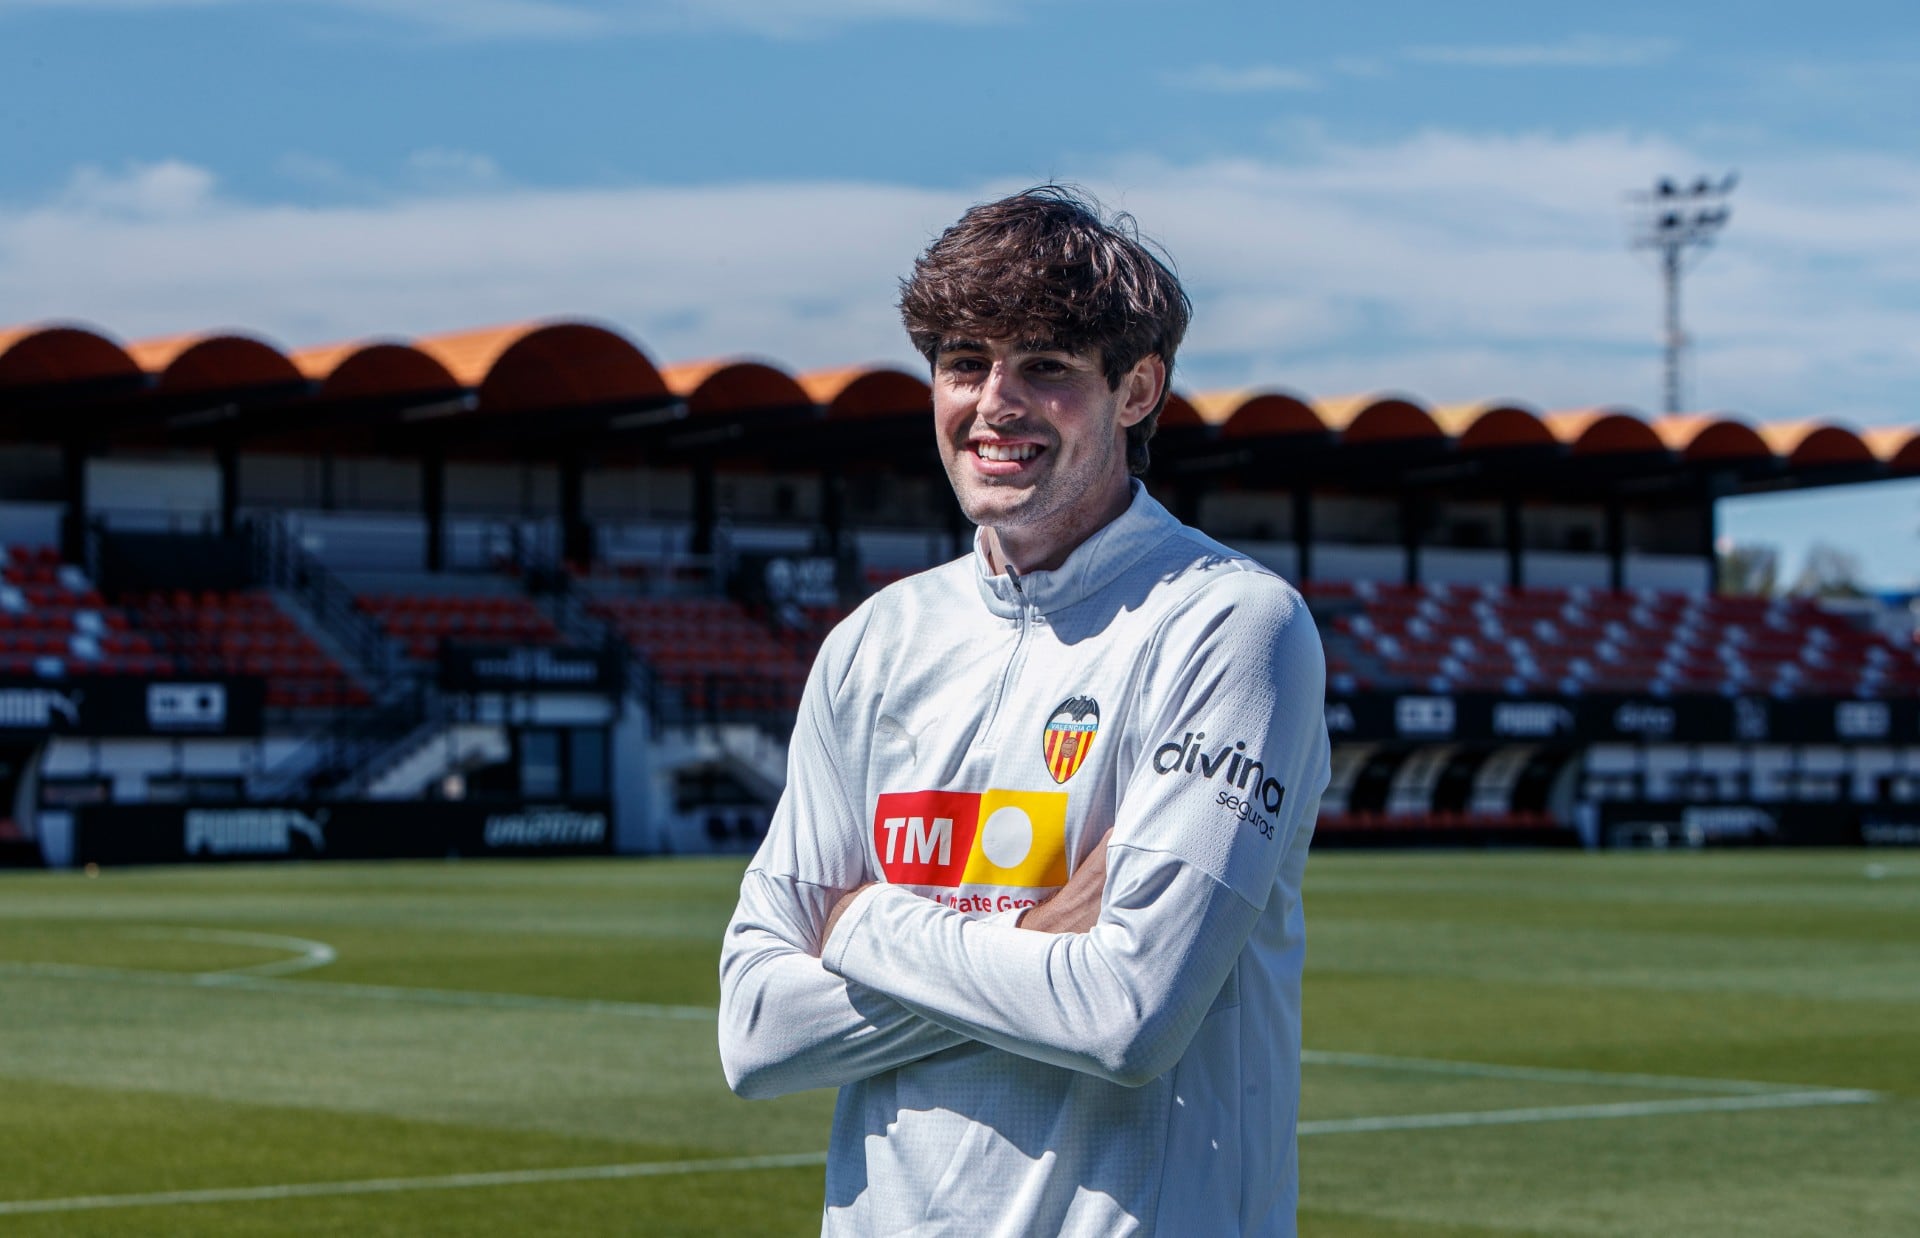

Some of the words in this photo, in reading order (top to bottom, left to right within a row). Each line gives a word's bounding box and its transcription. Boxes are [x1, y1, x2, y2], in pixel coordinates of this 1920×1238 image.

[1052, 723, 1084, 732] VALENCIA
[1153, 732, 1285, 817] divina
[1216, 791, 1275, 840] seguros
[884, 816, 953, 866] TM
